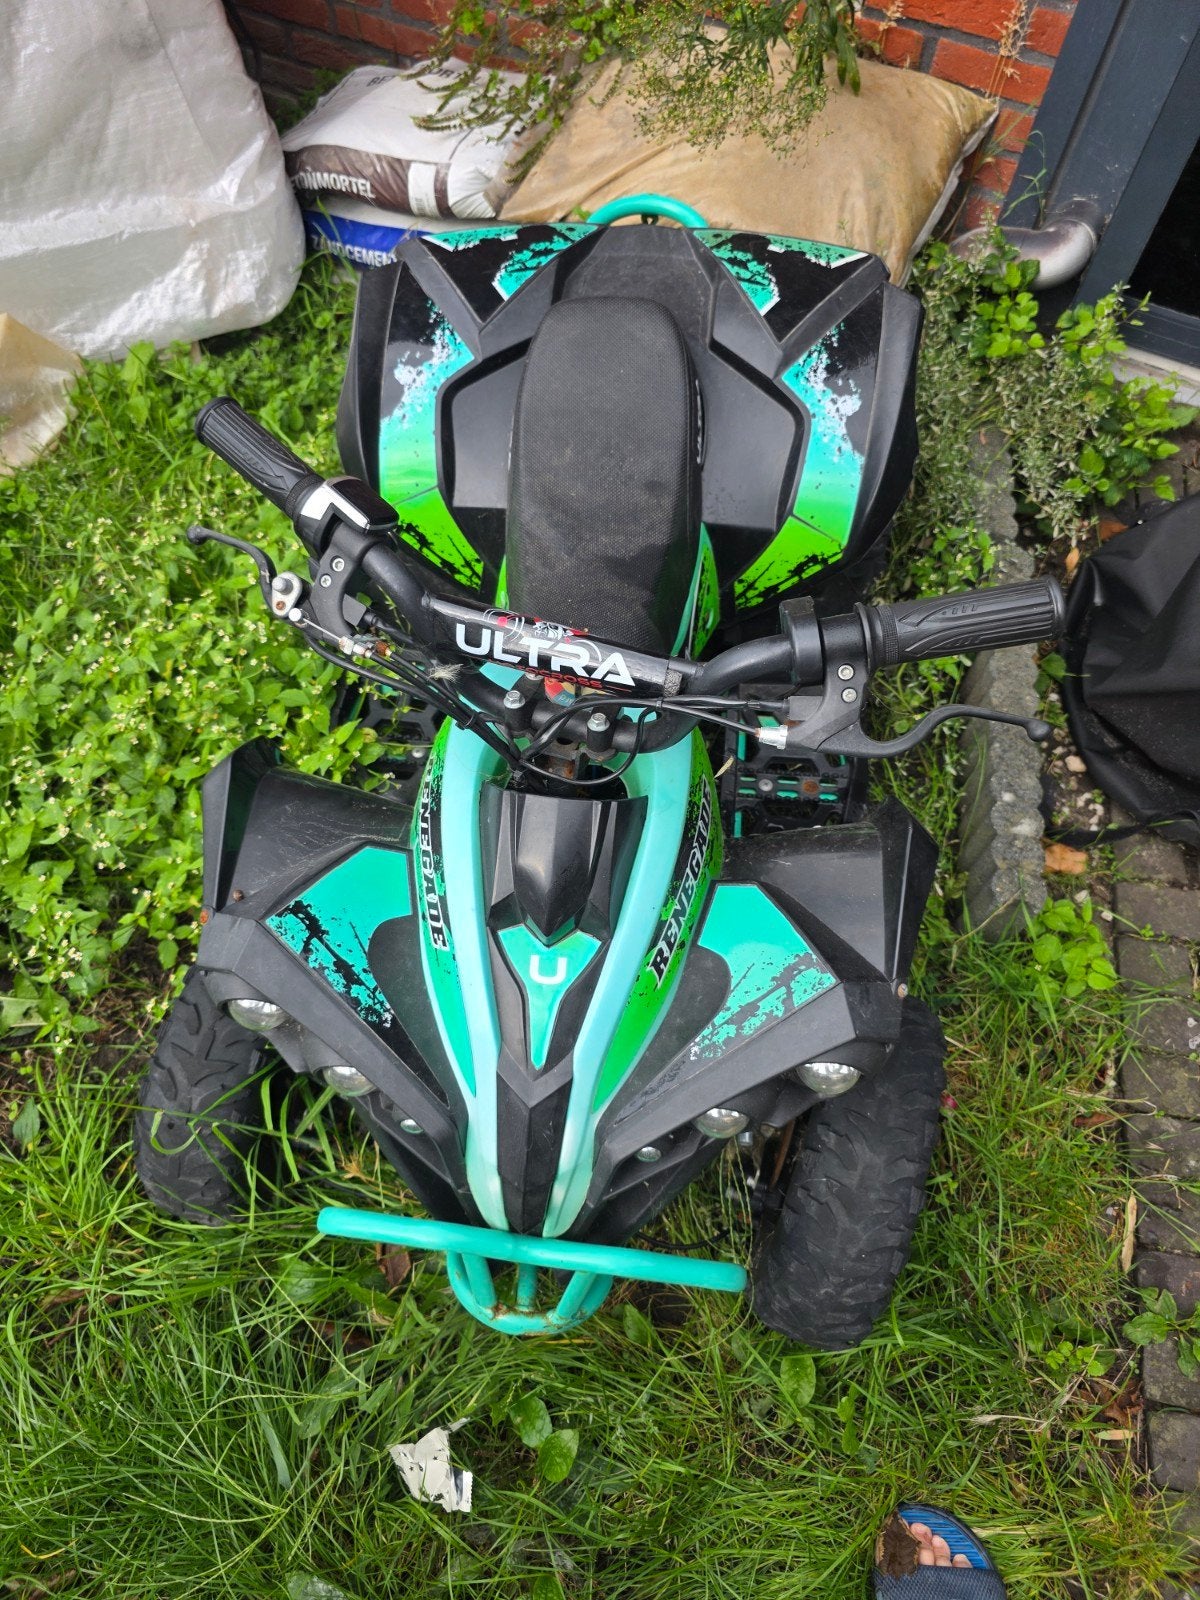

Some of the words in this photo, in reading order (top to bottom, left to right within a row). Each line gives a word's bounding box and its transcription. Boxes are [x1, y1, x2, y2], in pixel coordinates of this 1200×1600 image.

[291, 171, 377, 199] TONMORTEL
[455, 623, 636, 687] ULTRA
[647, 774, 712, 989] RENEGADE
[529, 954, 568, 985] U
